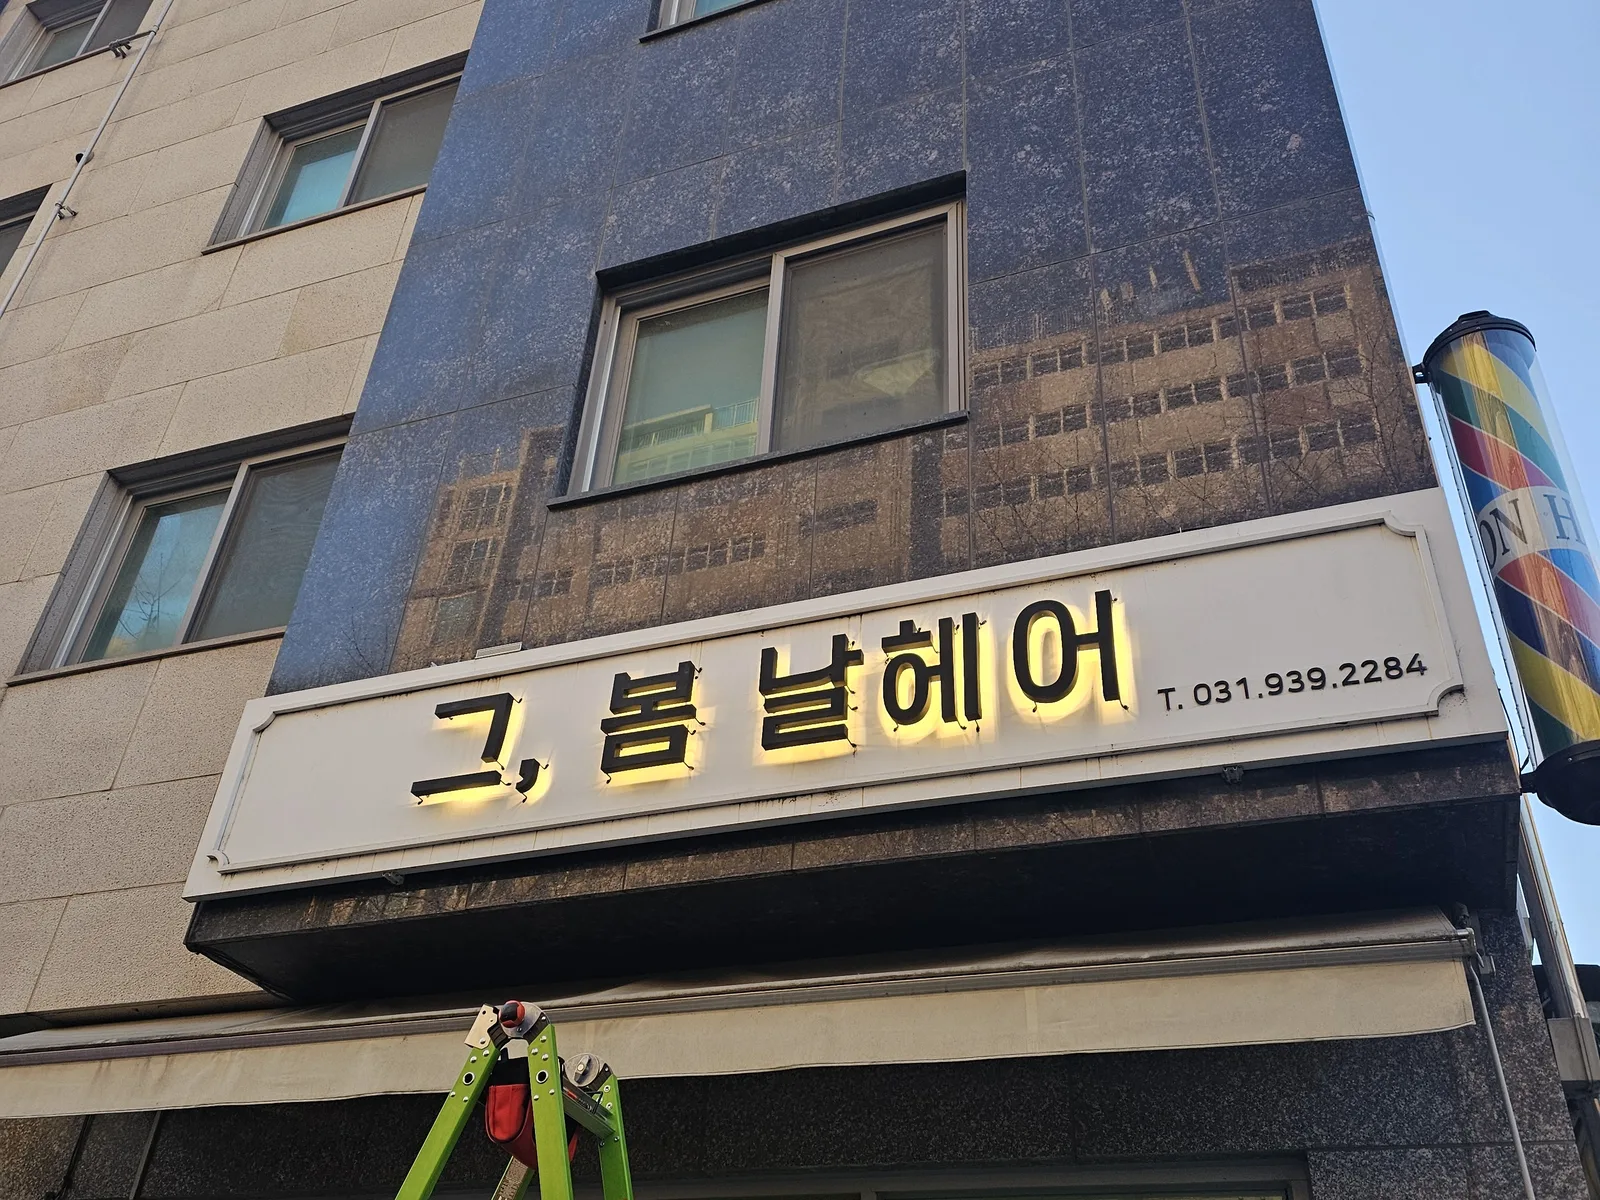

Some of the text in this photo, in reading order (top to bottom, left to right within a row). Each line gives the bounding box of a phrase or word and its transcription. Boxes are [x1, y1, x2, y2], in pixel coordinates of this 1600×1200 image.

[1157, 653, 1428, 711] T. 031.939.2284
[411, 692, 540, 797] 그,
